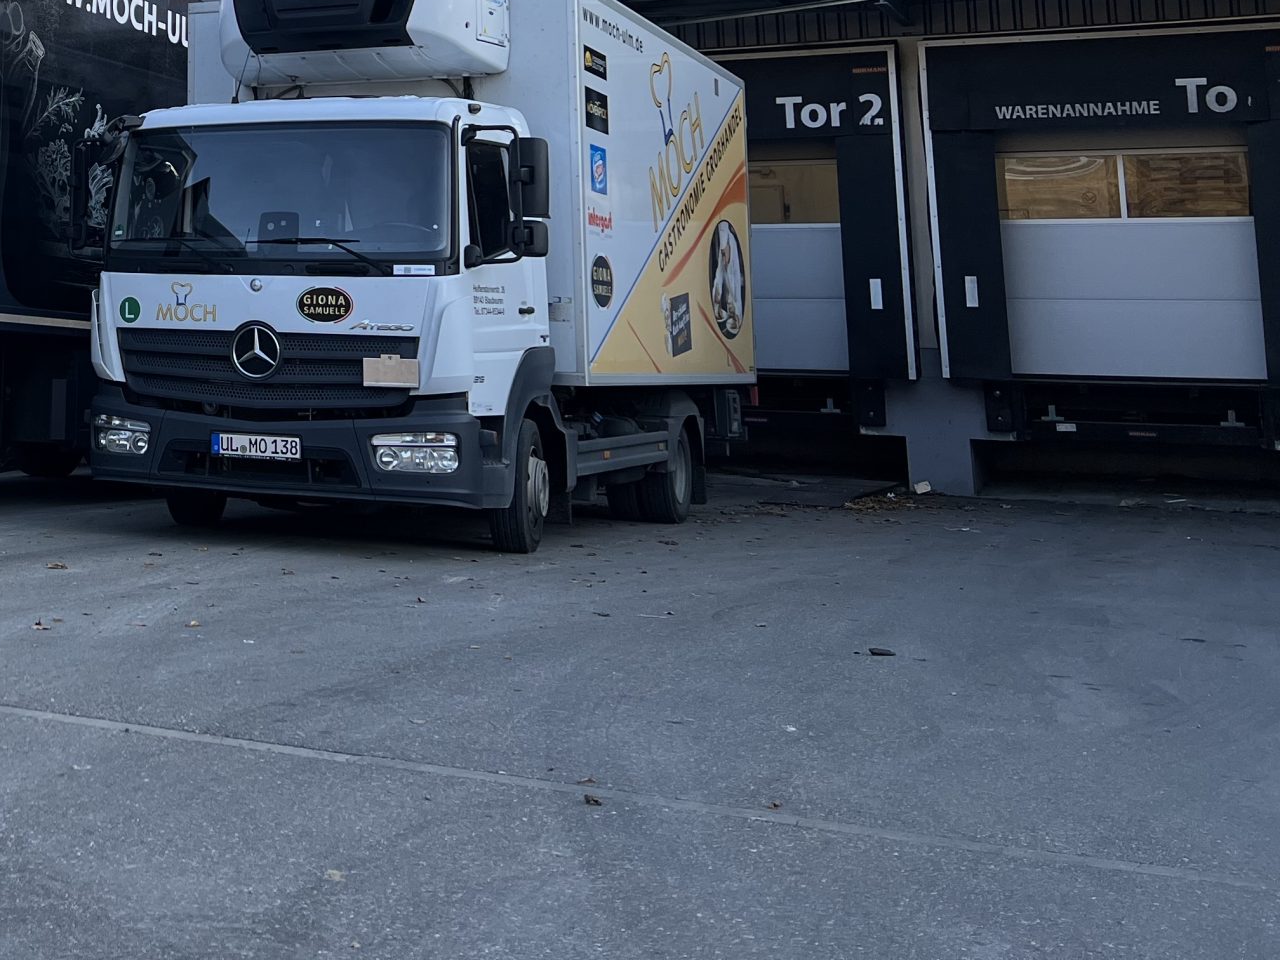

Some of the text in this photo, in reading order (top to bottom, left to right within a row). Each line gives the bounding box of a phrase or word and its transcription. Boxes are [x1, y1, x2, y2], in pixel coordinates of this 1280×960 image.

[583, 7, 643, 53] www.moch-ulm.de
[775, 96, 847, 129] Tor
[995, 100, 1161, 120] WARENANNAHME
[649, 91, 705, 233] MOCH
[658, 179, 706, 273] GASTRONOMIE
[593, 266, 611, 281] GIONA
[303, 294, 346, 306] GIONA
[125, 304, 135, 319] L
[156, 304, 217, 321] MOCH
[303, 306, 346, 315] SAMUELE
[220, 436, 298, 456] UL MO 138
